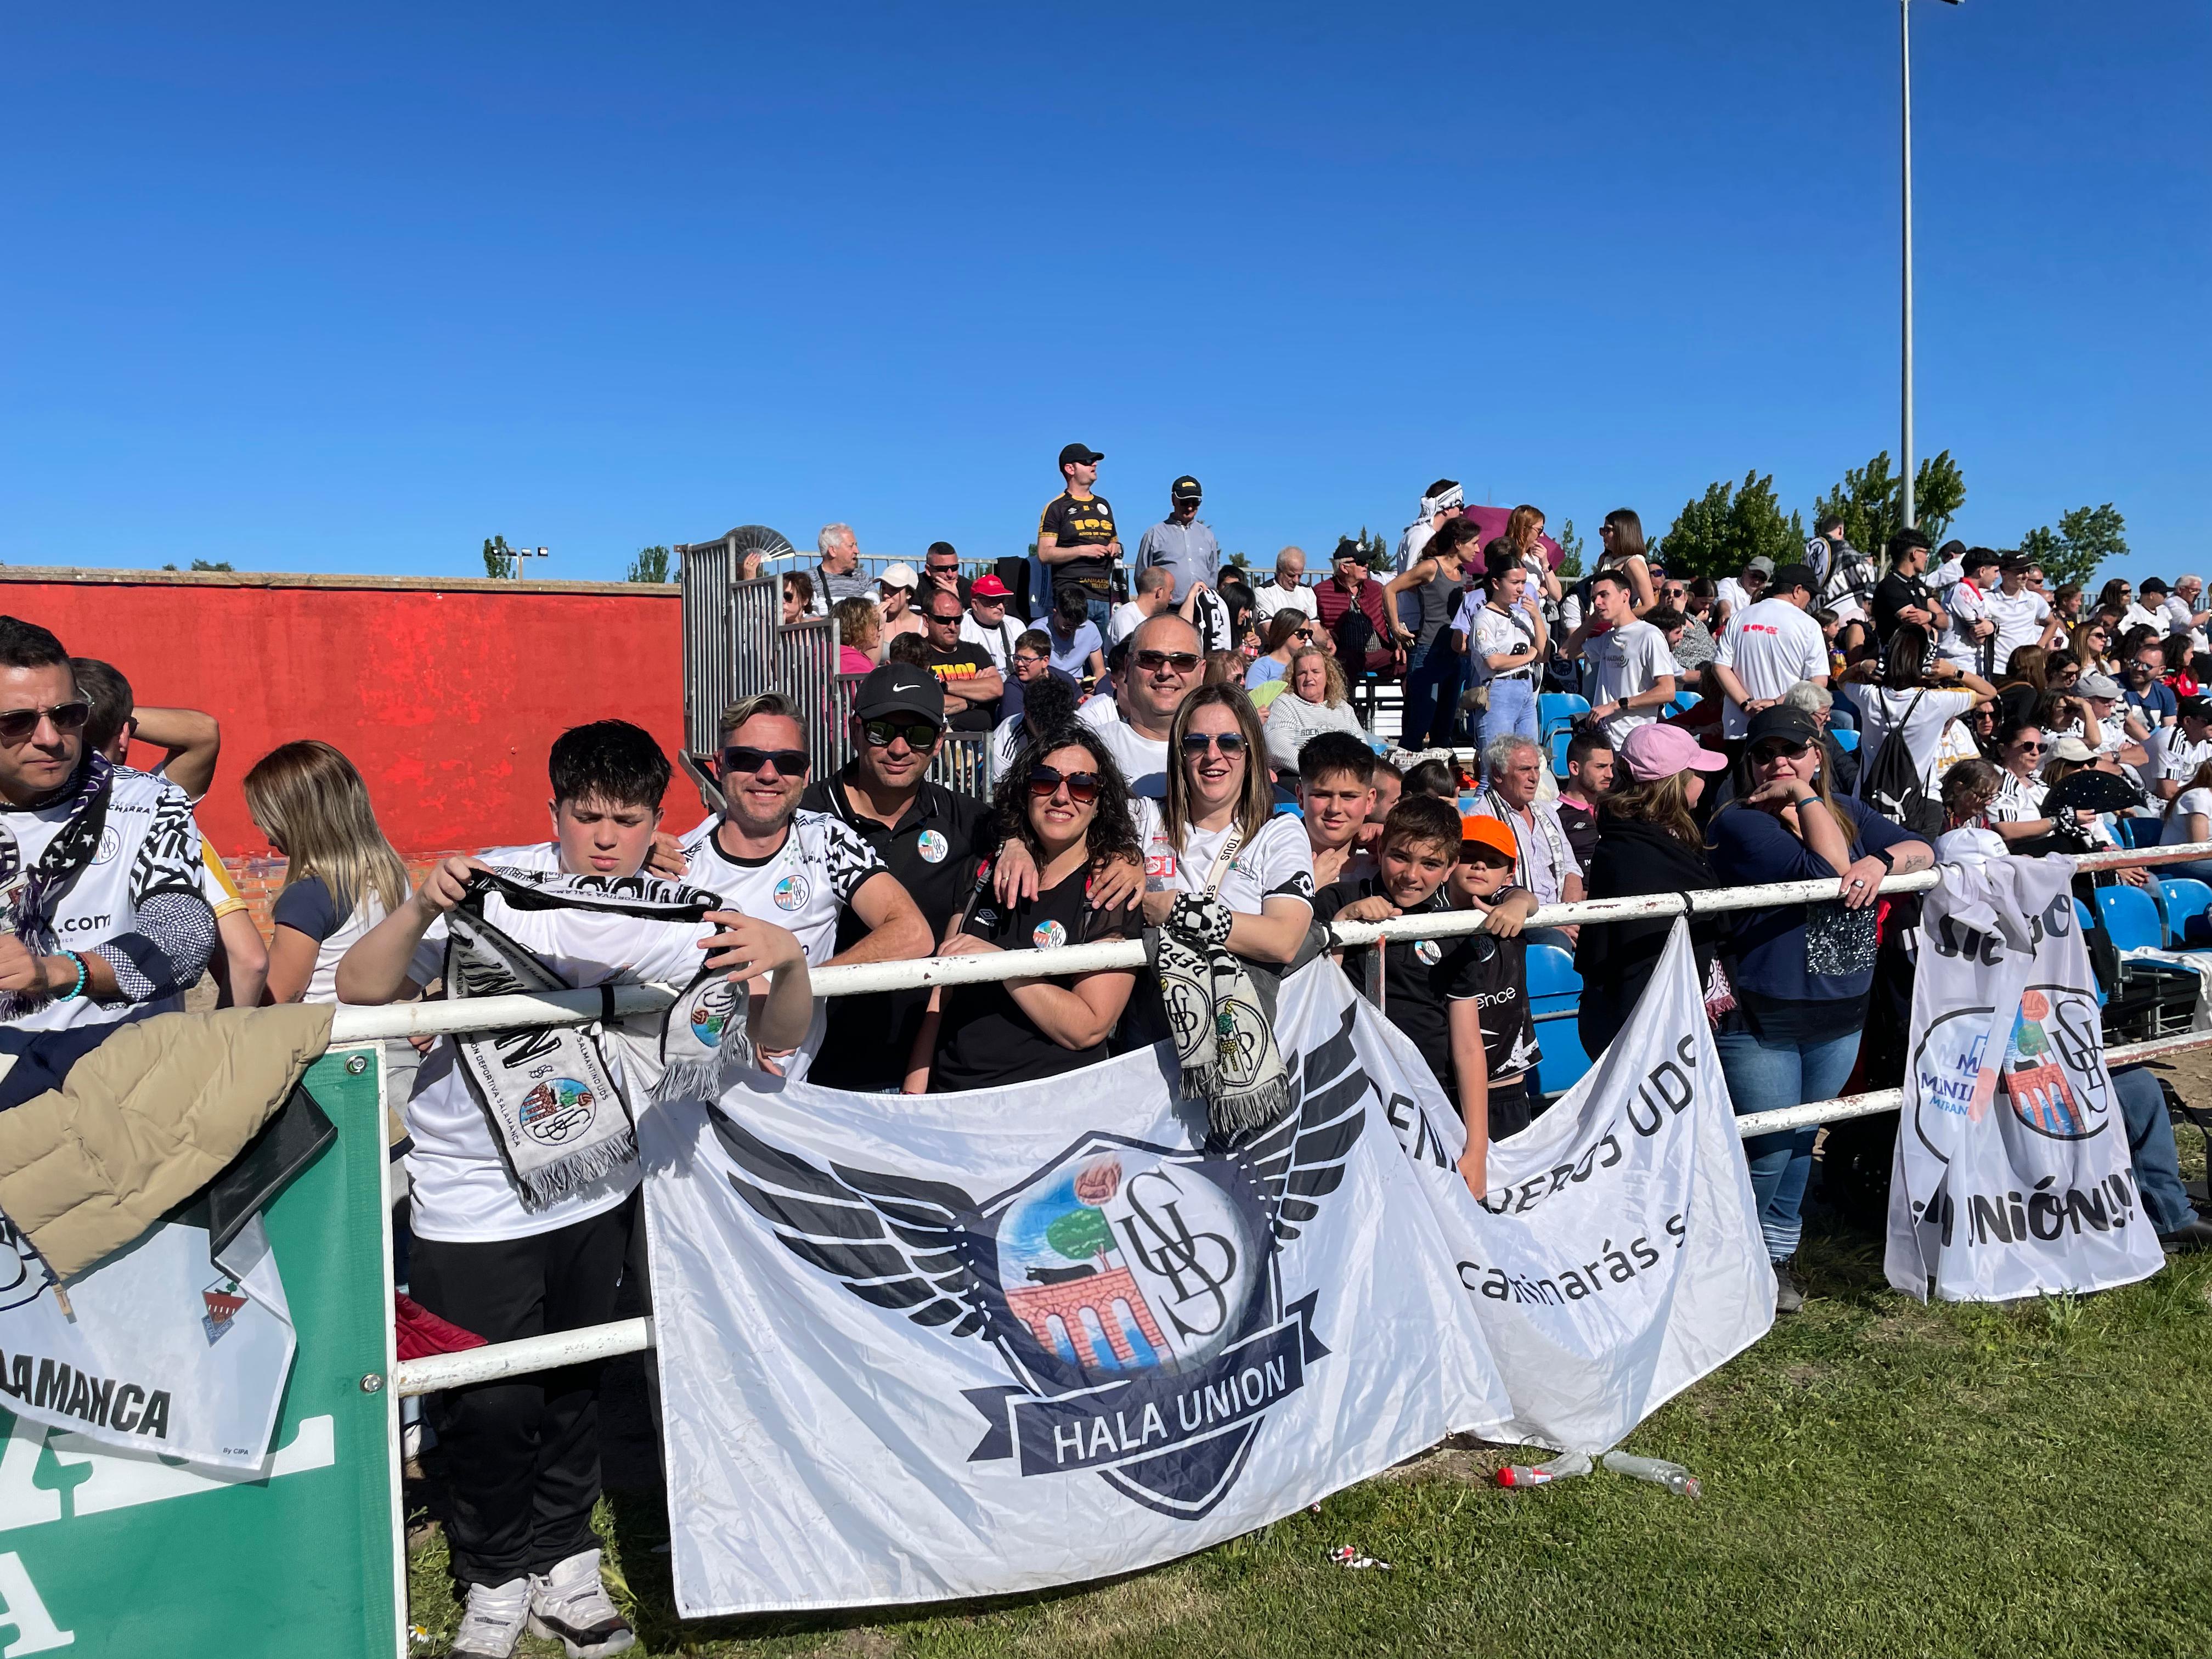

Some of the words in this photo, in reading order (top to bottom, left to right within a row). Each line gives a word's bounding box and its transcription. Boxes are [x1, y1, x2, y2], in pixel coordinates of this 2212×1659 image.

[1220, 838, 1240, 861] TOUS
[577, 1036, 601, 1085] SALMANTINO
[476, 1054, 500, 1098] DEPORTIVA
[496, 1098, 521, 1148] SALAMANCA
[1054, 1402, 1168, 1464] HALA
[1177, 1355, 1286, 1431] UNION
